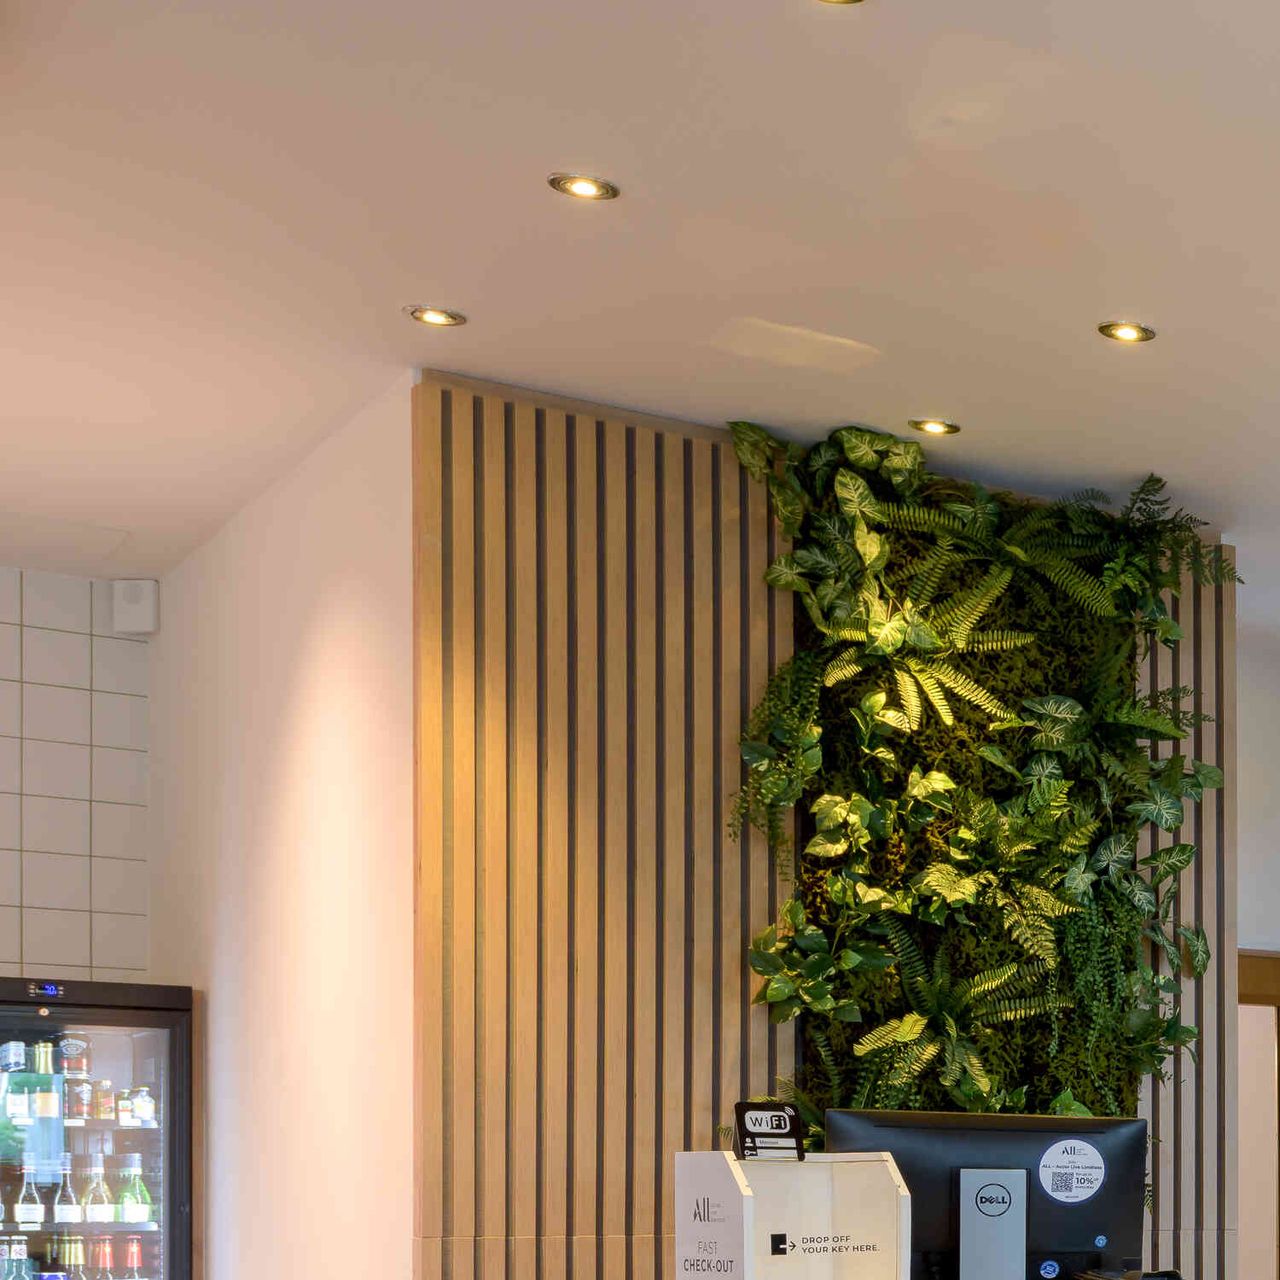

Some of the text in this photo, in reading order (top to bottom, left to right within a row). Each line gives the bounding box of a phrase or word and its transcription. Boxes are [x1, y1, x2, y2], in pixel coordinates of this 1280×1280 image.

[750, 1116, 785, 1128] WiFi
[1075, 1177, 1094, 1185] 10%
[980, 1196, 1008, 1204] DELL
[801, 1235, 851, 1245] DROP OFF
[697, 1241, 718, 1255] FAST
[801, 1244, 880, 1254] YOUR KEY HERE.
[683, 1259, 734, 1272] CHECK-OUT
